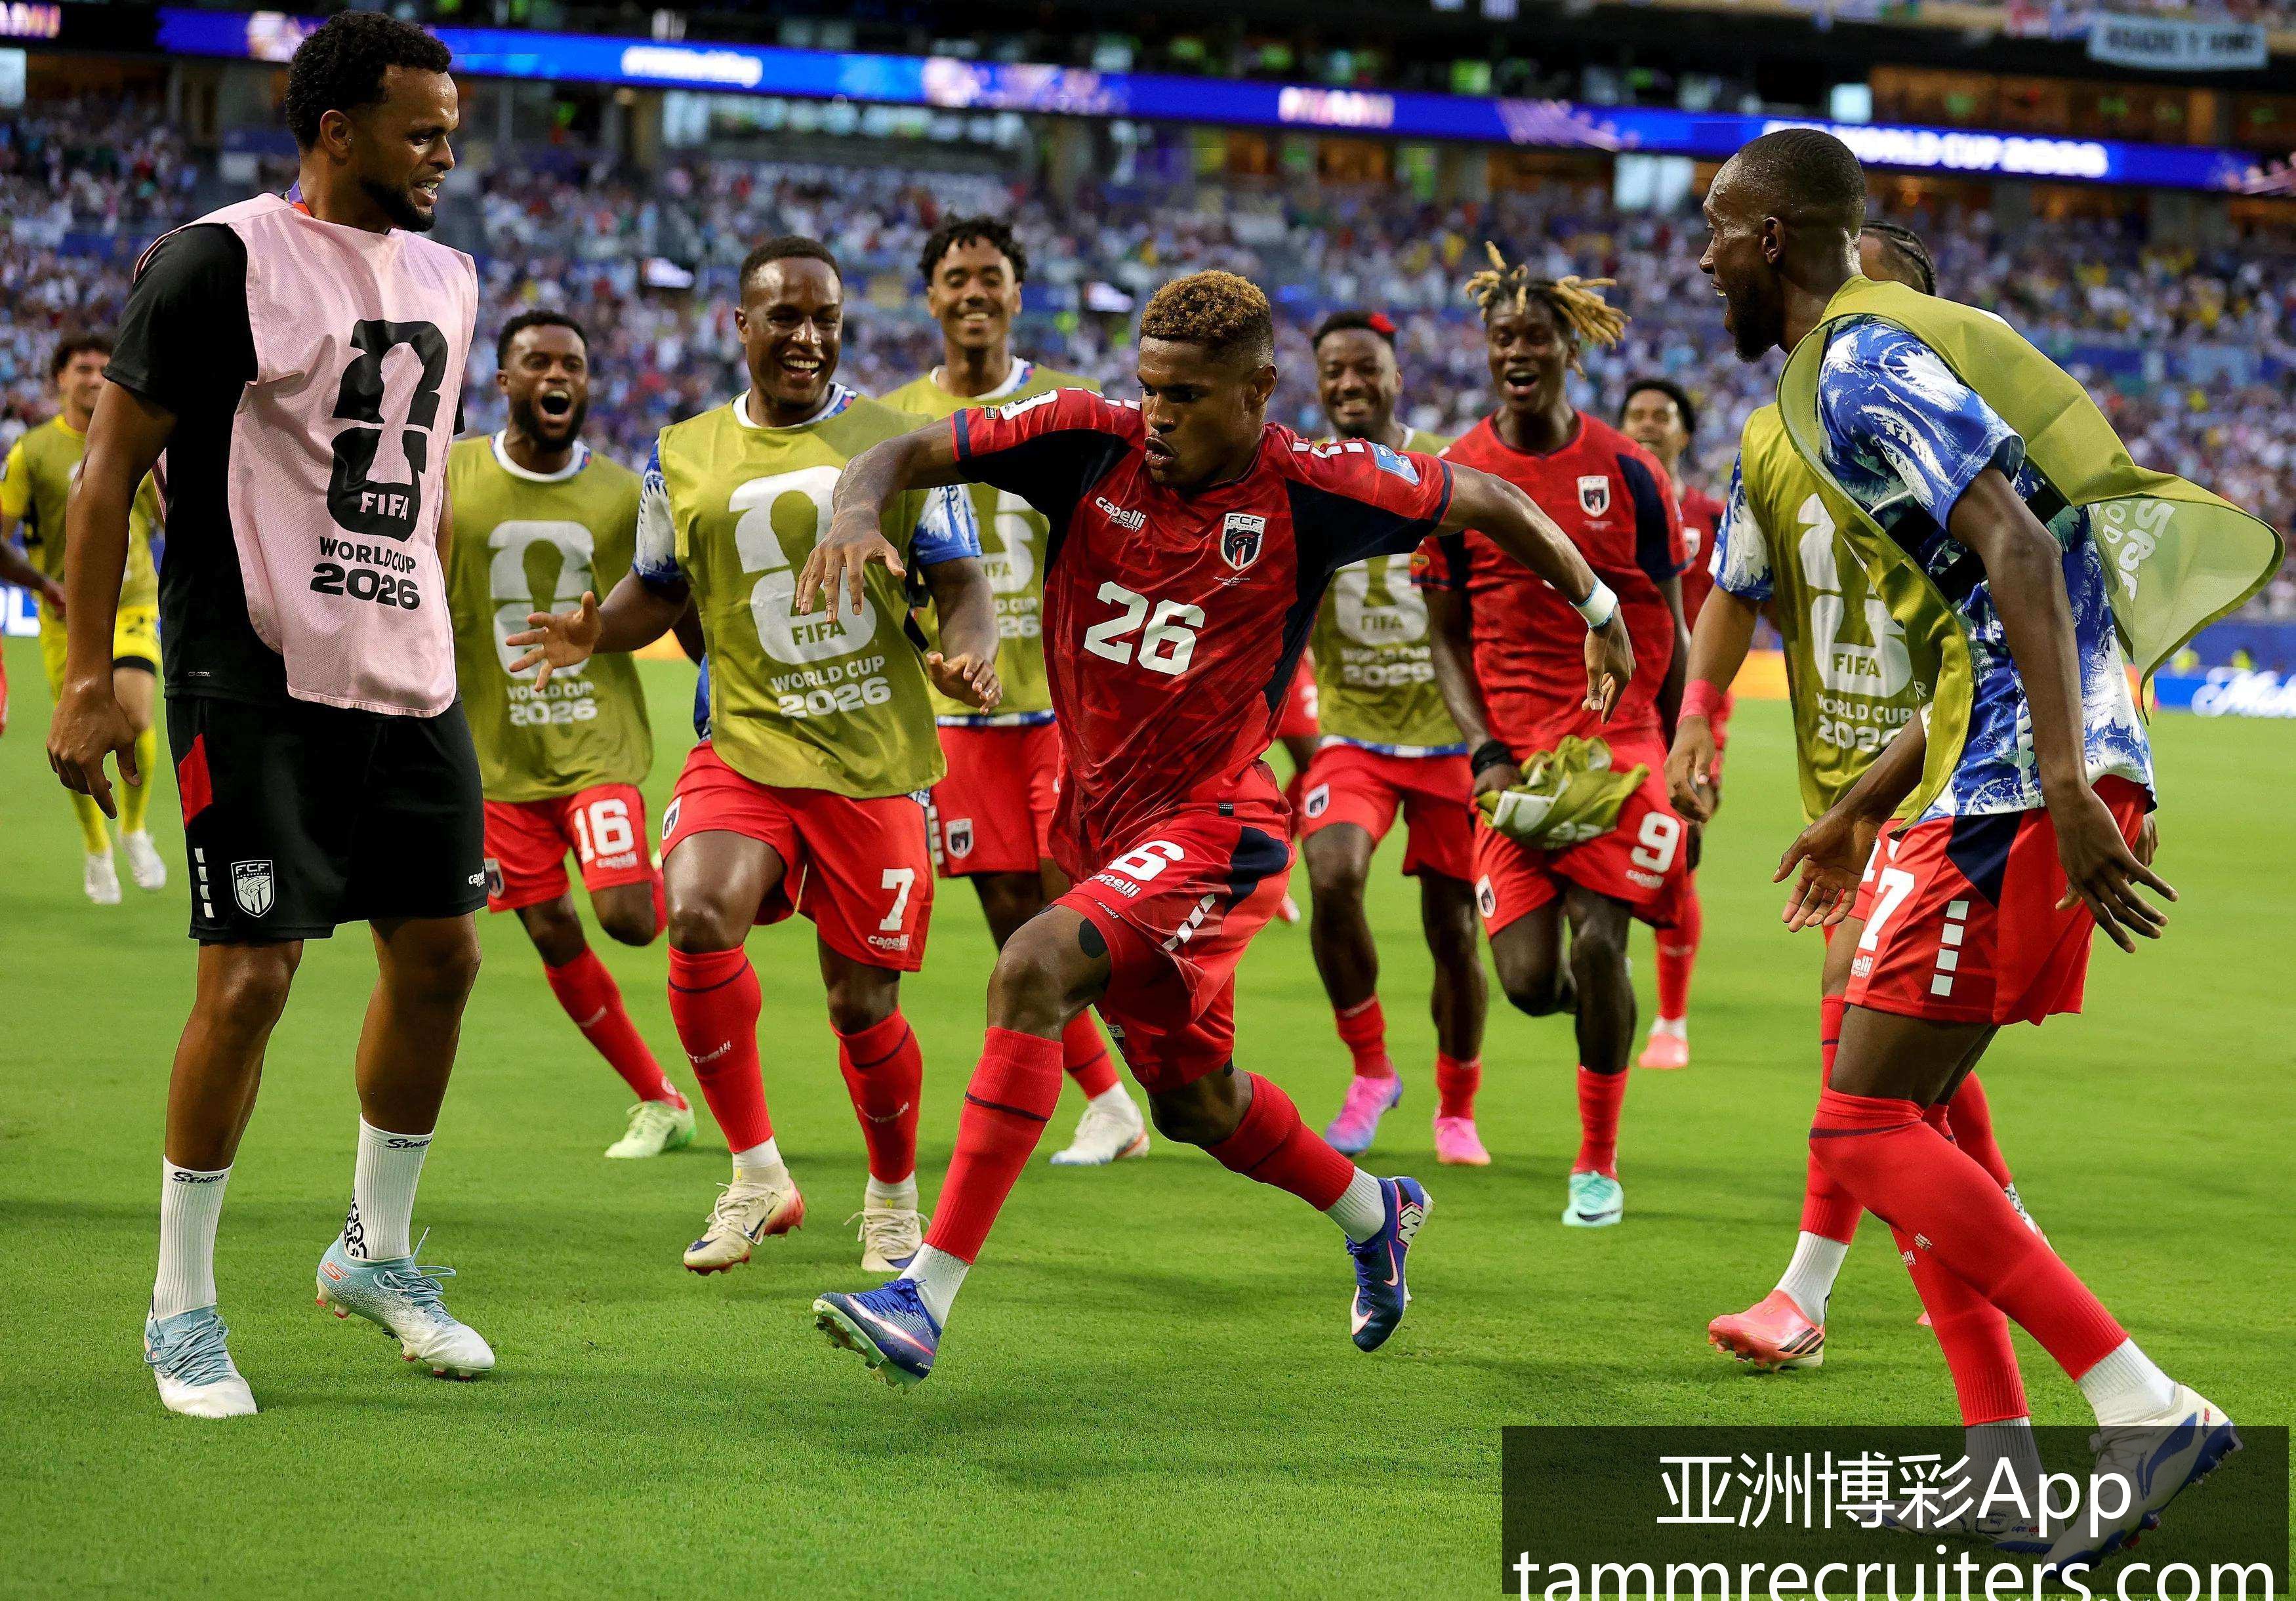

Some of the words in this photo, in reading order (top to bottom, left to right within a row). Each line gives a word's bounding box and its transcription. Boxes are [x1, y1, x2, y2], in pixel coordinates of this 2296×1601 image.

[360, 492, 409, 521] FIFA
[1096, 497, 1146, 529] capelli
[1228, 516, 1263, 525] FCF
[1111, 517, 1140, 533] SPORT
[319, 536, 392, 567] WORLD
[392, 552, 417, 575] CUP
[310, 562, 420, 611] 2026
[792, 618, 848, 645] FIFA
[998, 615, 1042, 639] 26
[1084, 580, 1205, 676] 26
[771, 666, 844, 693] WORLD
[846, 655, 886, 679] CUP
[1833, 653, 1881, 678] FIFA
[509, 697, 598, 727] 2026
[777, 676, 892, 719] 2026
[1872, 705, 1914, 725] CUP
[574, 798, 635, 863] 16
[1630, 811, 1681, 873] 9
[236, 863, 270, 874] FCF
[879, 868, 915, 931] 7
[1858, 866, 1916, 952] 7
